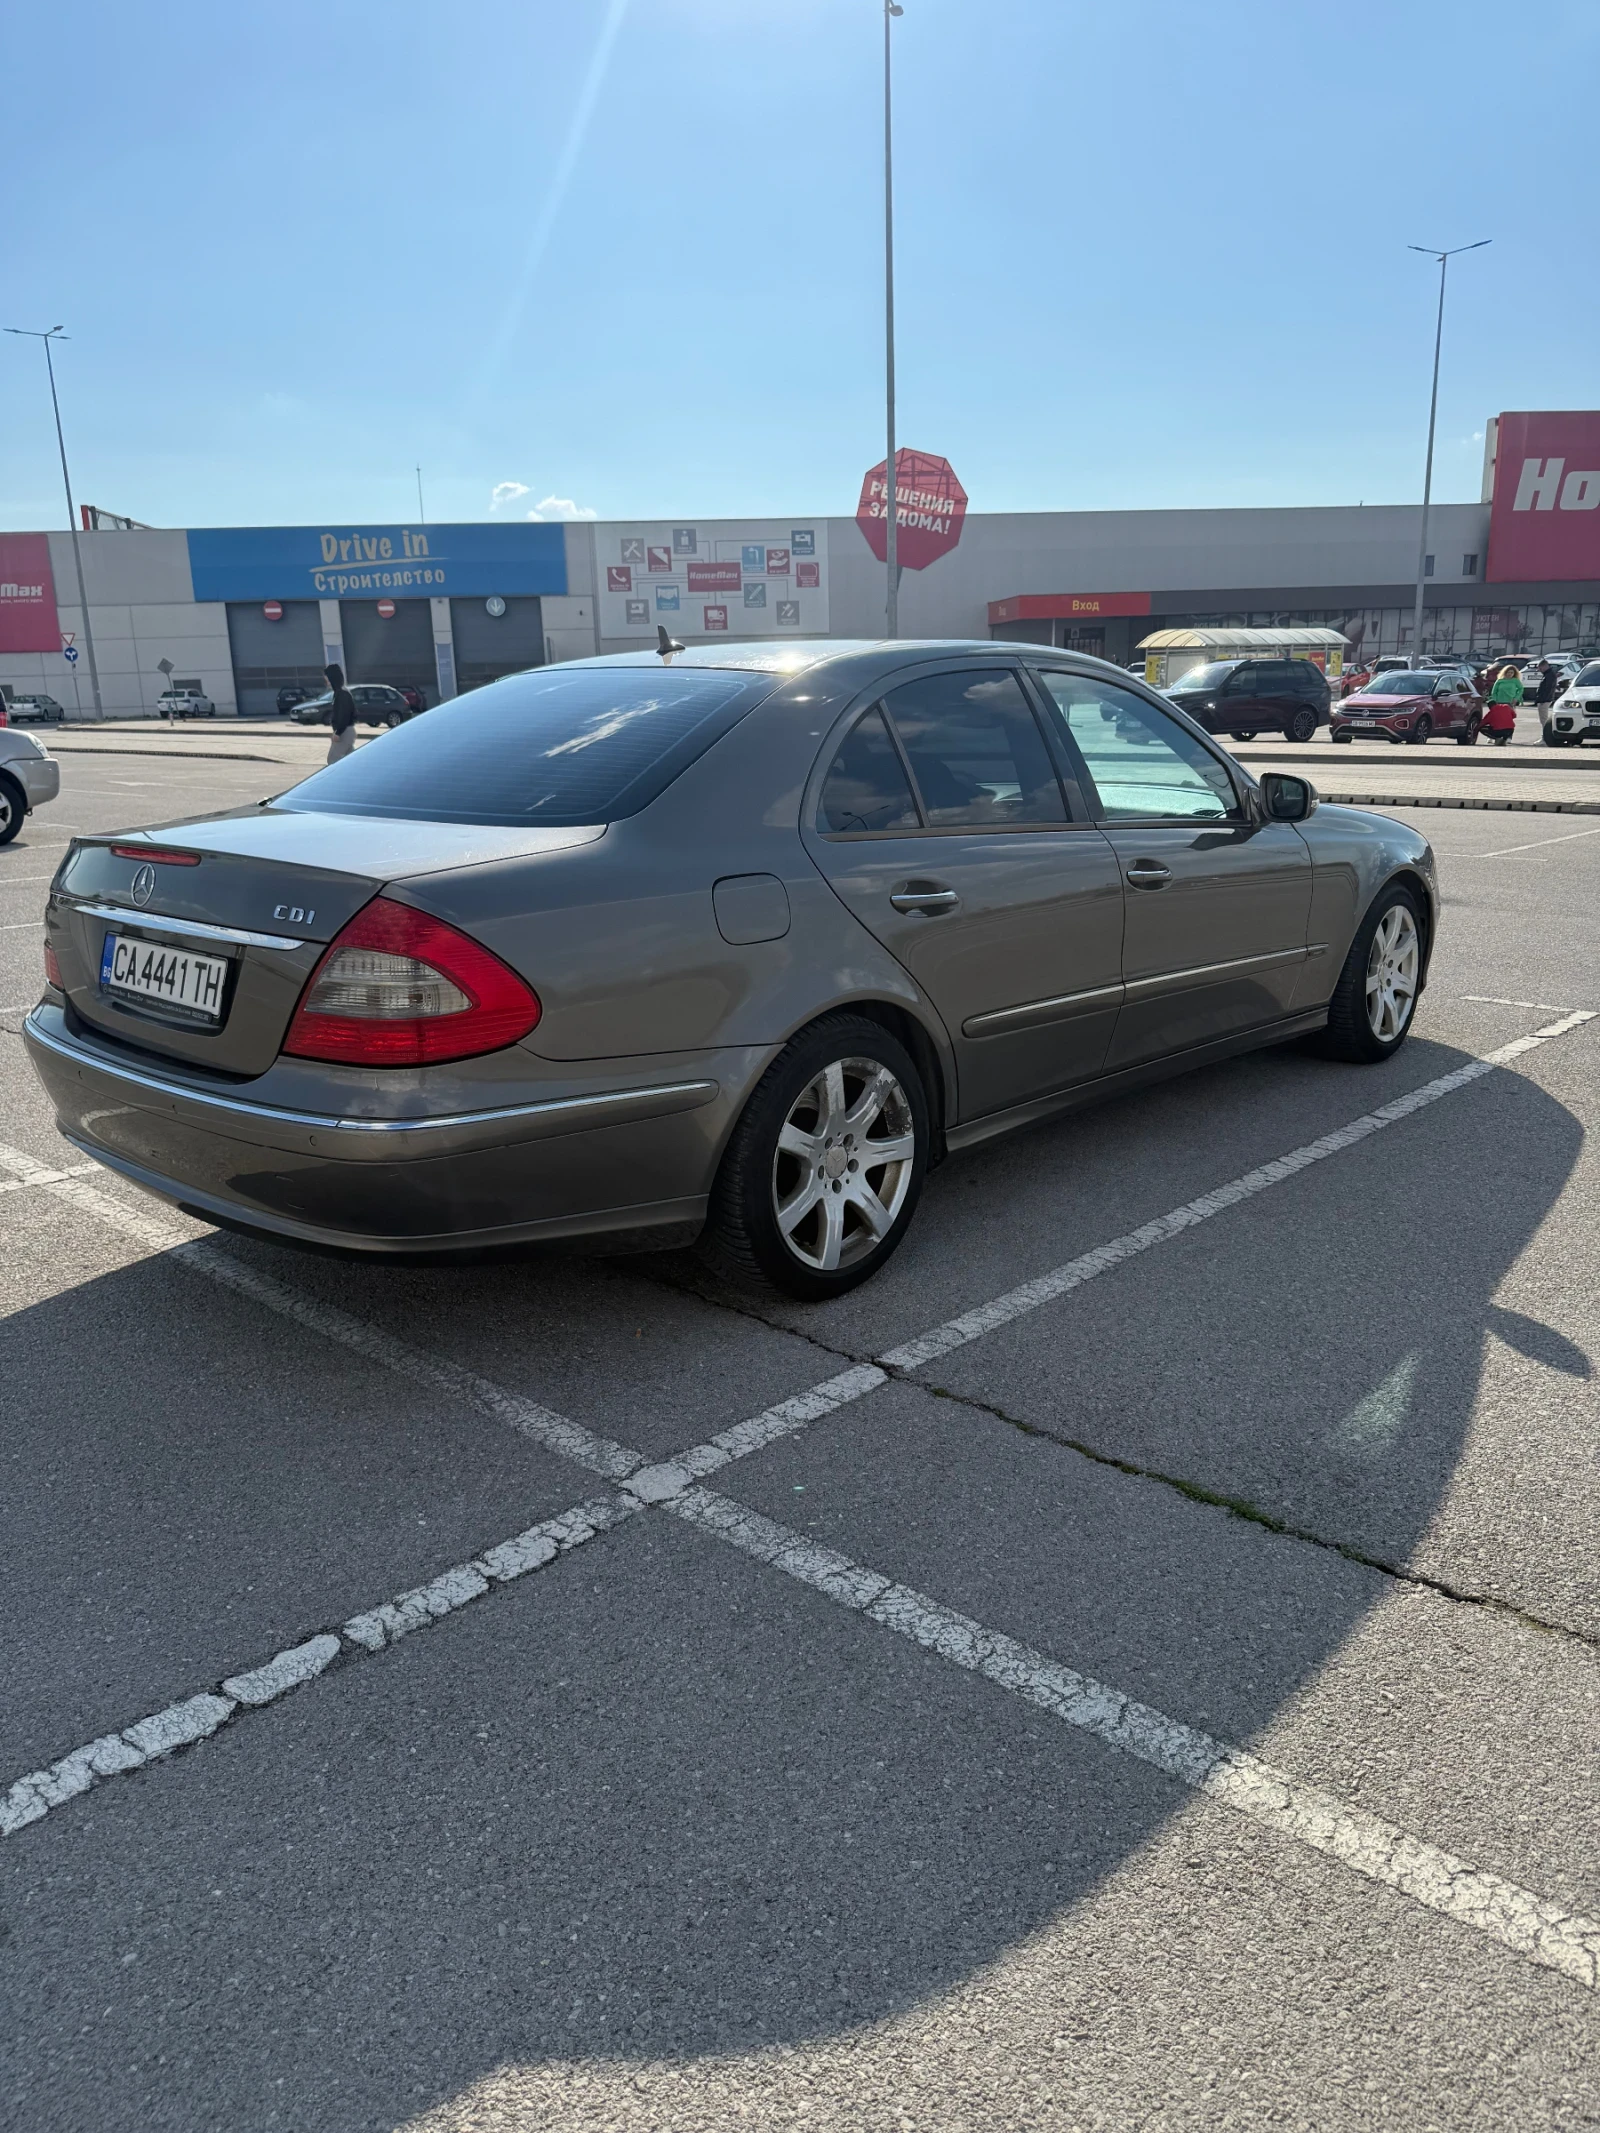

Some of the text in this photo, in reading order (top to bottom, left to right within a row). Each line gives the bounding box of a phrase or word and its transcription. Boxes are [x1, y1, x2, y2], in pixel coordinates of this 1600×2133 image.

[1512, 457, 1600, 511] Ho
[869, 480, 955, 516] РЕШЕНИЯ
[895, 508, 951, 535] ДОМА!
[320, 530, 430, 563] Drive in
[314, 568, 446, 594] Строителство
[689, 571, 738, 580] HomeMax
[0, 583, 43, 597] Max
[1072, 600, 1100, 612] Вход
[1474, 622, 1491, 630] ДОМ
[273, 905, 316, 925] CDI
[102, 966, 112, 978] BG
